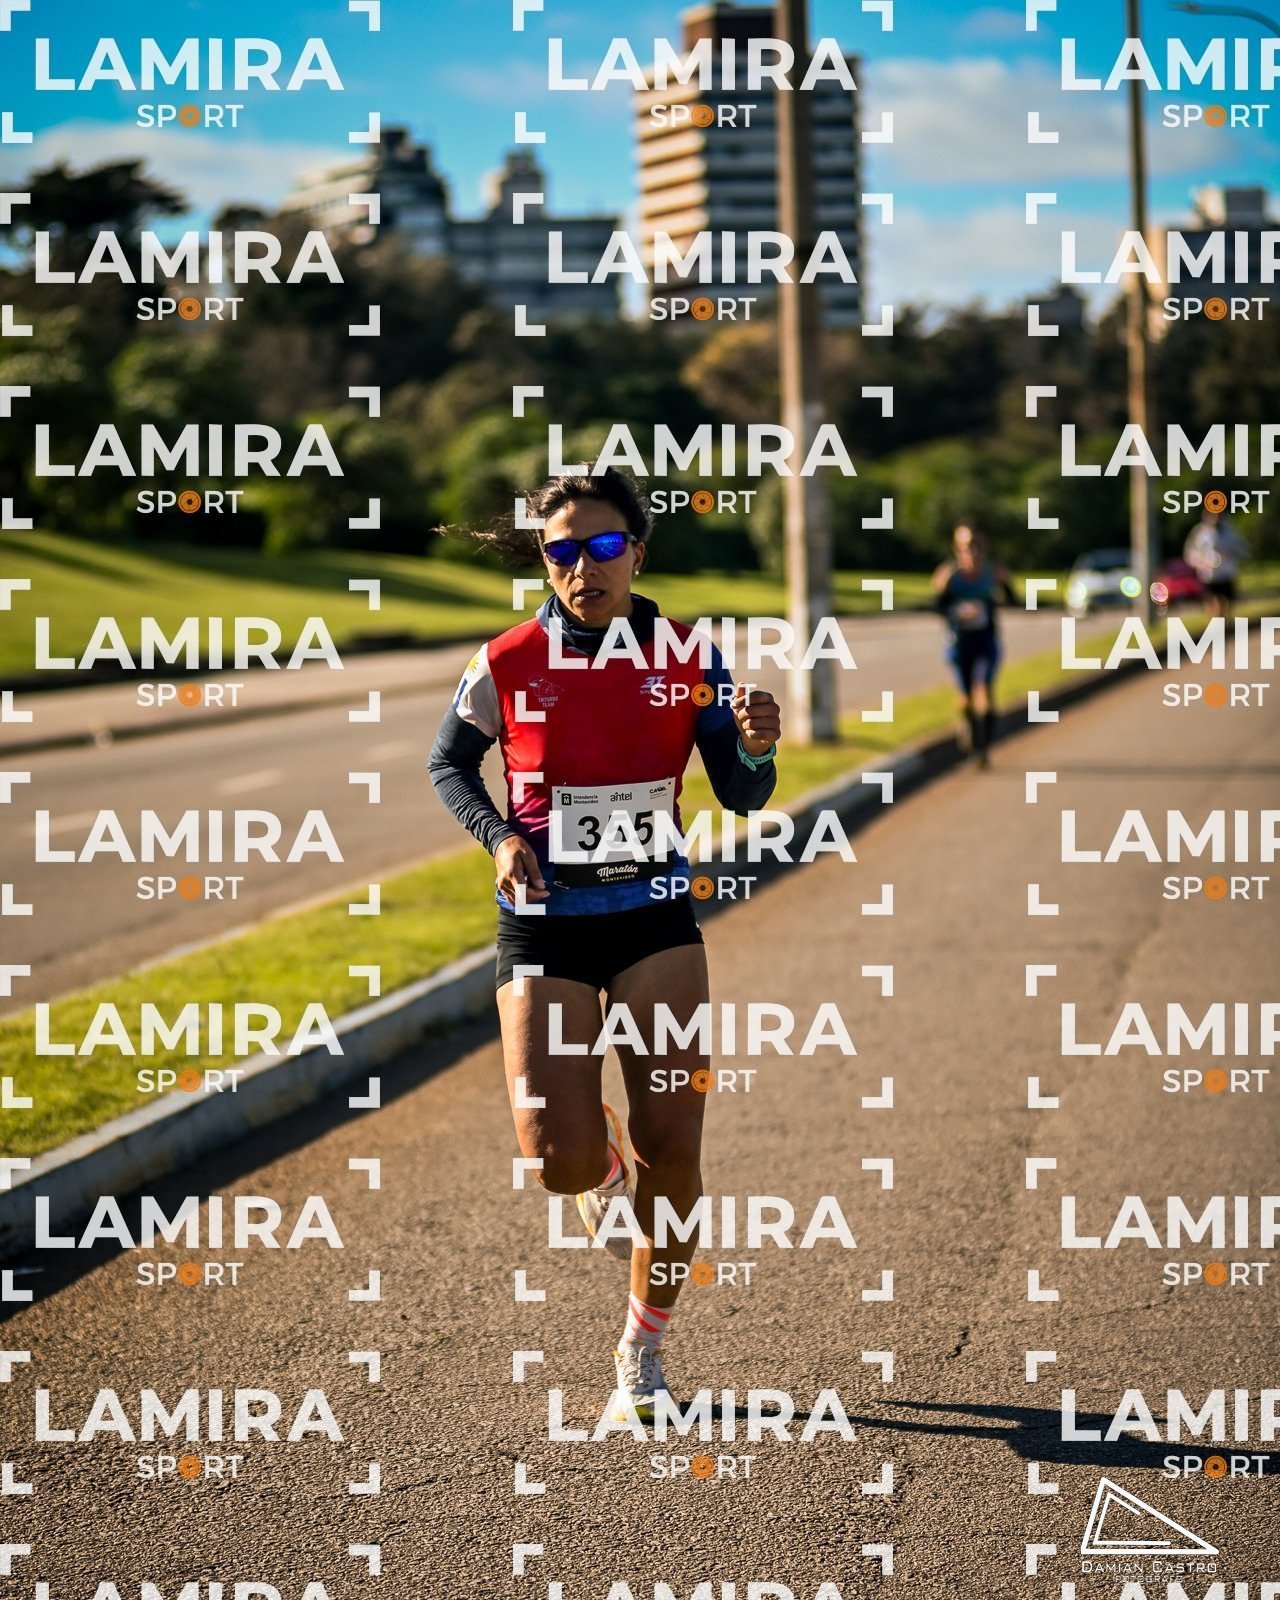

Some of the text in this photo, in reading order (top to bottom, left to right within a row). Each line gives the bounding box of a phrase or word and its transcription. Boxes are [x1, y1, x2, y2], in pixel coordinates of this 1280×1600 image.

[610, 792, 632, 802] antel
[577, 810, 653, 851] 355
[597, 864, 639, 877] Maratón
[601, 874, 635, 882] MONTEVIDEO
